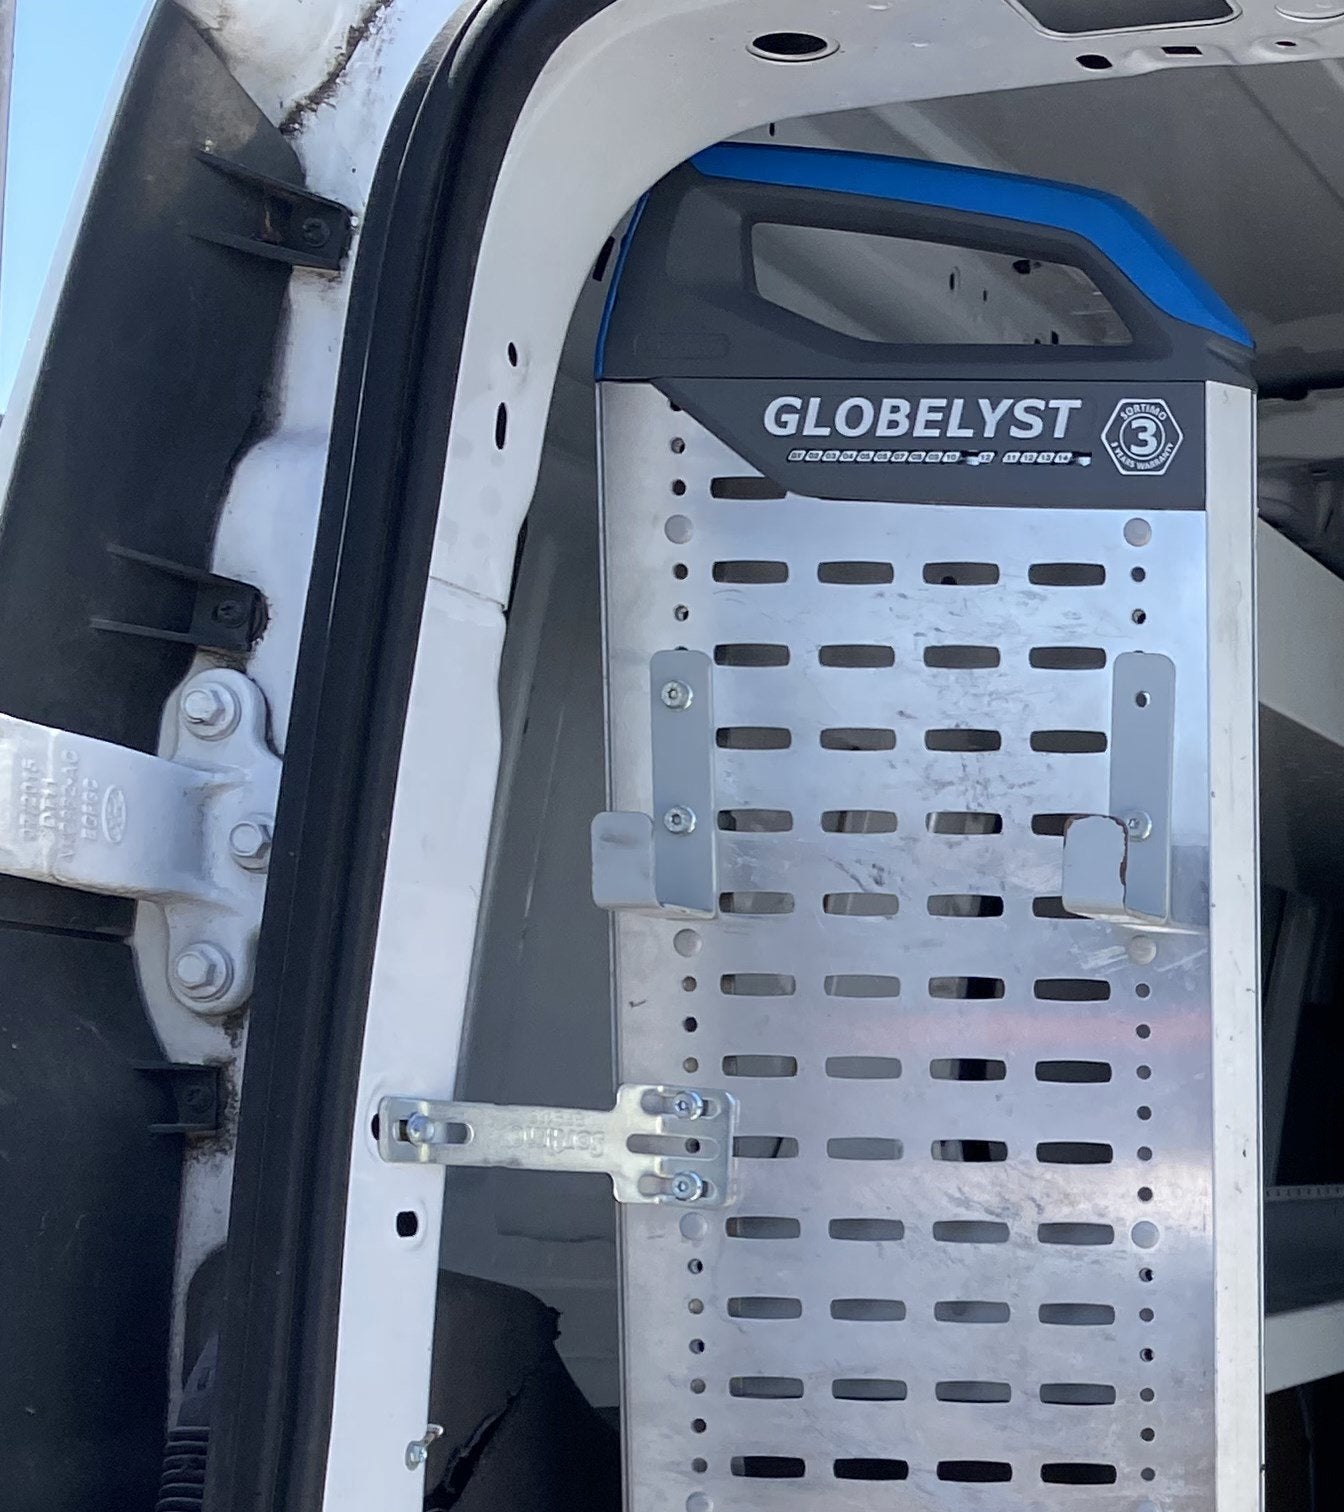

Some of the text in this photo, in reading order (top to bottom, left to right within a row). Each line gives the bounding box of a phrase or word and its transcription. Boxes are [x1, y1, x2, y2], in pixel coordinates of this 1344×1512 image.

[763, 396, 1083, 438] GLOBELYST
[1120, 404, 1167, 420] SORTIMO
[1130, 418, 1158, 455] 3
[1136, 442, 1174, 470] WARRANTY
